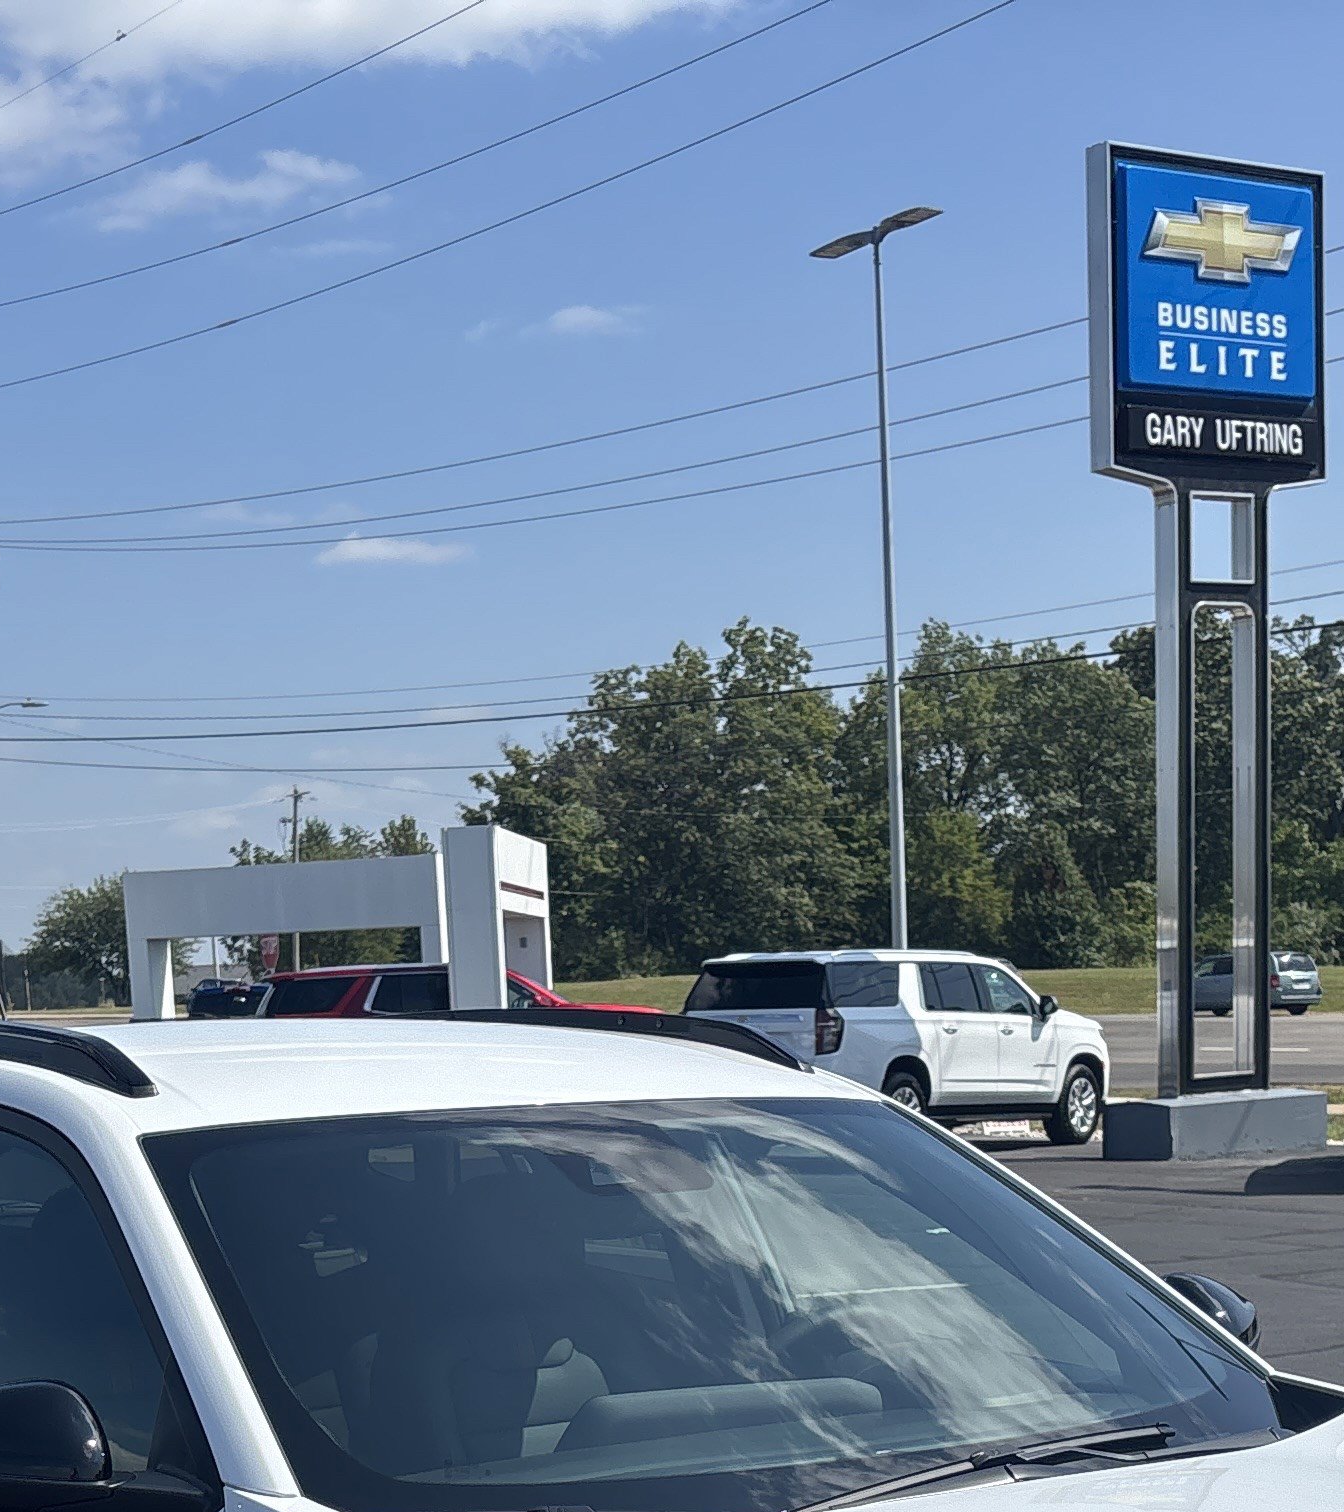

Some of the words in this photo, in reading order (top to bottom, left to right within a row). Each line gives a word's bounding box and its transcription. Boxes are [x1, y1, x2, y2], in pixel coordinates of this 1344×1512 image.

[1158, 302, 1287, 338] BUSINESS
[1158, 340, 1288, 381] ELITE
[1145, 412, 1205, 449] GARY
[1214, 417, 1304, 456] UFTRING
